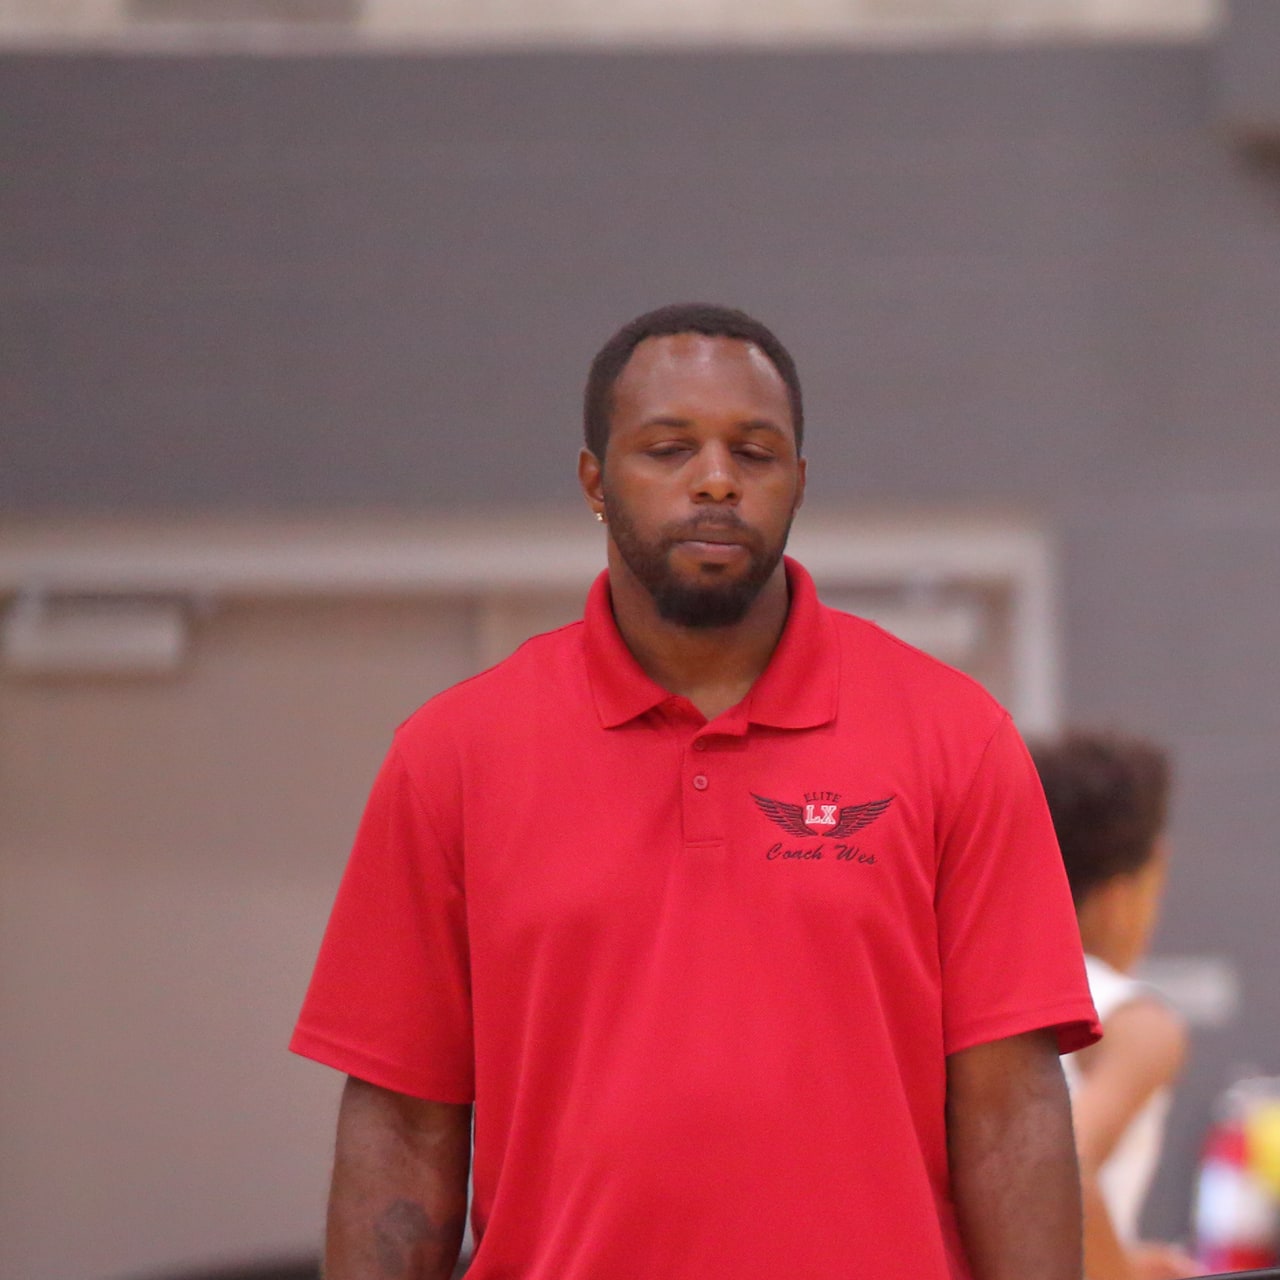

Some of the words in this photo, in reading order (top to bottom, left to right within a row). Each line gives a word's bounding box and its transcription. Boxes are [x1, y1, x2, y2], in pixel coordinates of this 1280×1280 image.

[803, 791, 842, 802] ELITE
[805, 804, 837, 825] LX
[766, 843, 824, 861] Coach
